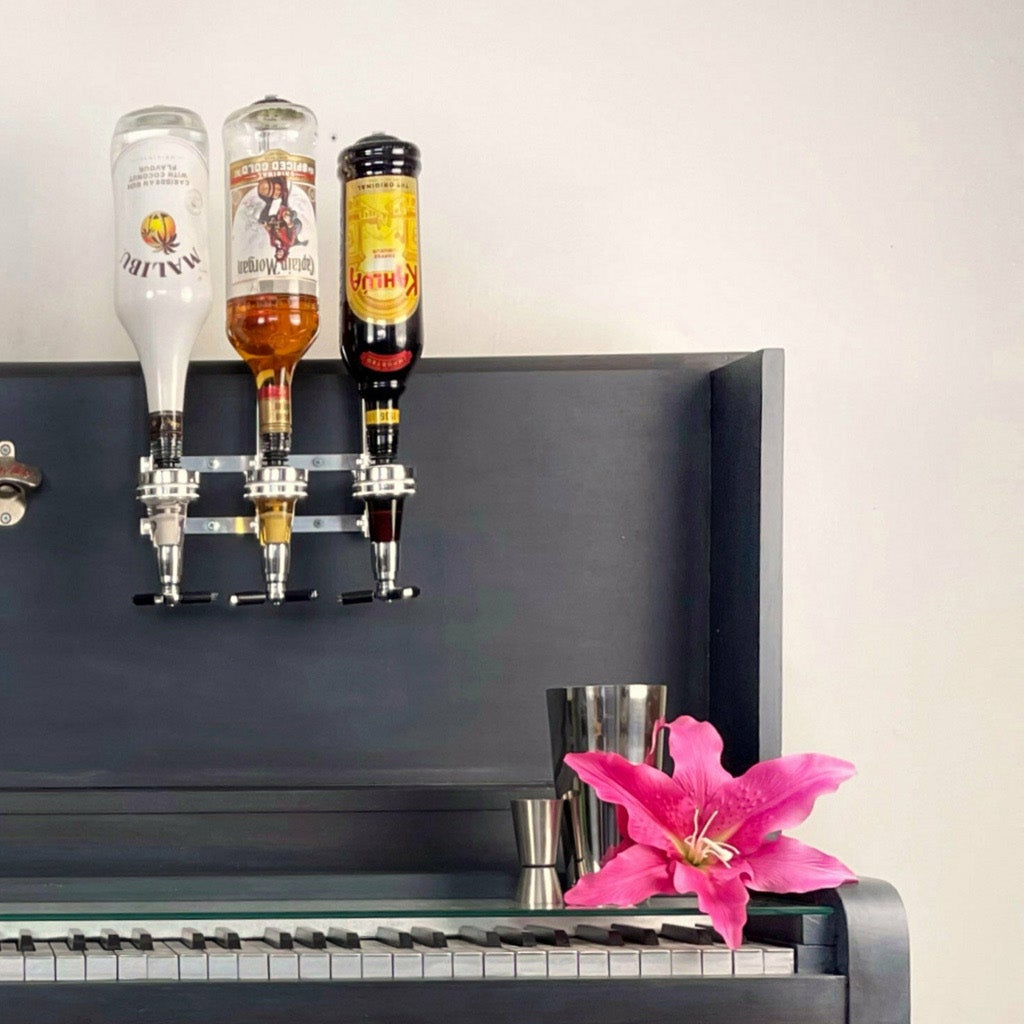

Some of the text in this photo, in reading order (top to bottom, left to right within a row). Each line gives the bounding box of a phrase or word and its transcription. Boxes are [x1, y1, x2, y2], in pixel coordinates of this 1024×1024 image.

[138, 164, 176, 172] FLAVOUR
[241, 162, 269, 175] GOLD
[272, 161, 308, 172] SPICED
[128, 172, 165, 182] COCONUT
[144, 178, 189, 186] CARIBBEAN
[120, 246, 201, 278] MALIBU
[237, 255, 314, 276] Captain Morgan
[350, 263, 418, 297] KAHLÚA
